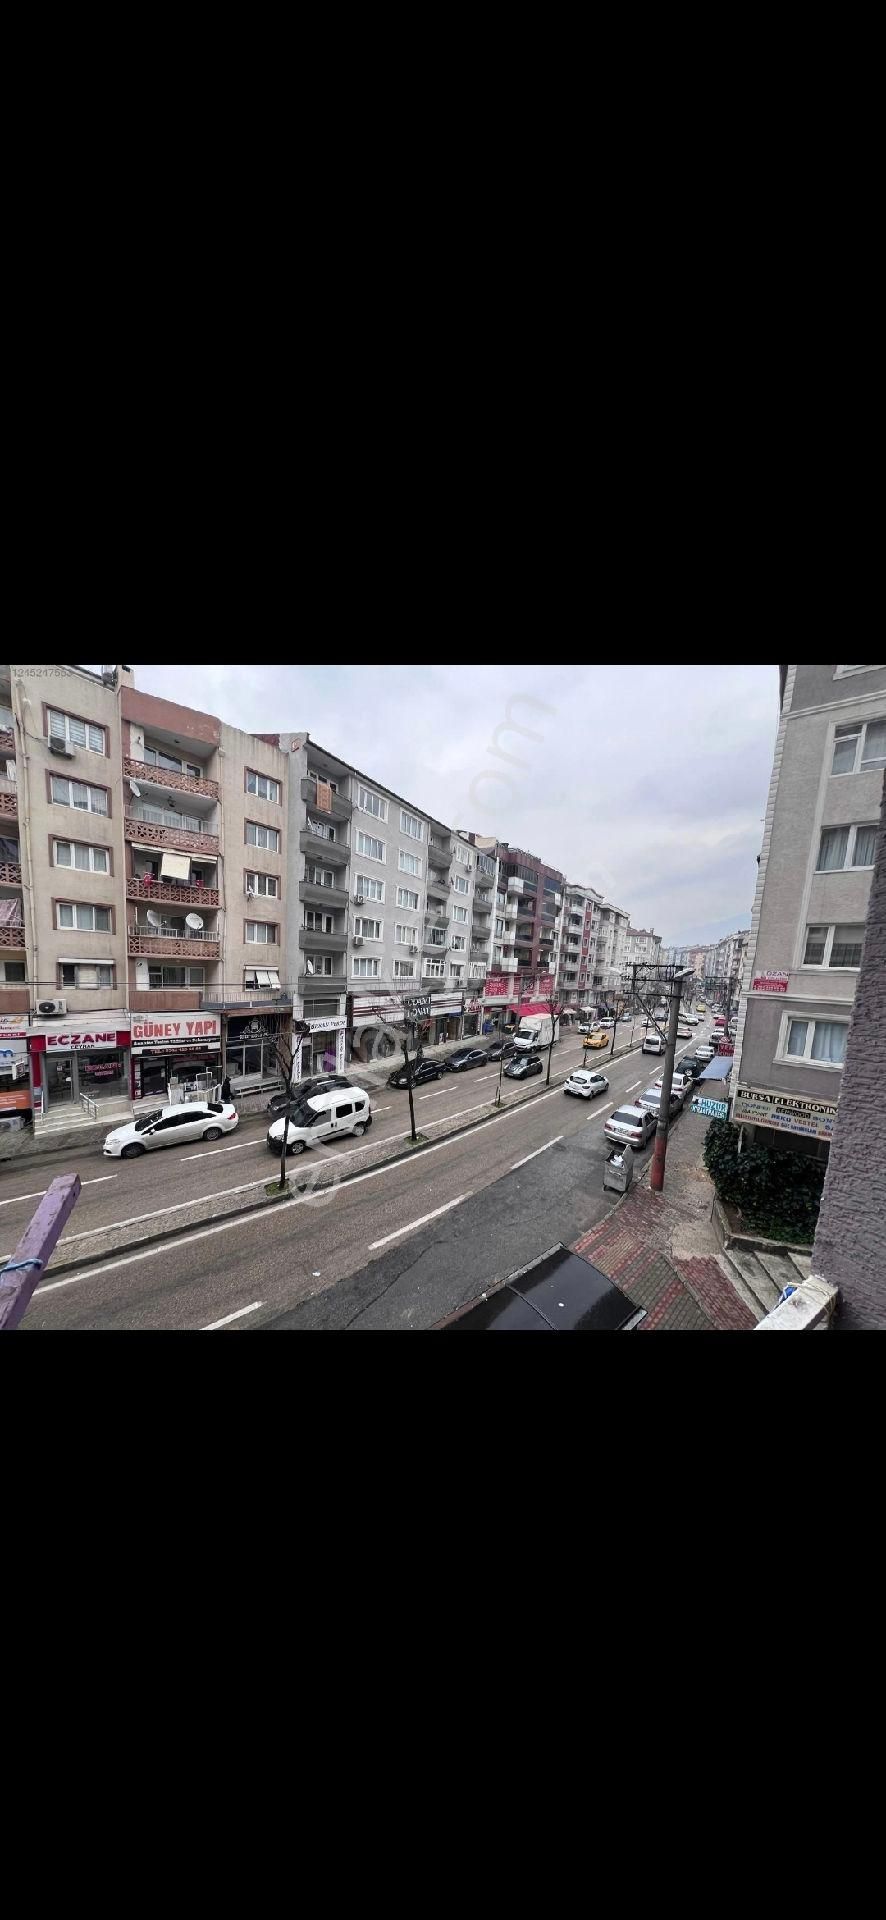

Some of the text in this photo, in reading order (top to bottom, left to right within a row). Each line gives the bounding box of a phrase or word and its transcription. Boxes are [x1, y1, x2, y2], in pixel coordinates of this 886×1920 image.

[133, 1019, 217, 1039] GÜNEY YAPI
[47, 1032, 116, 1046] ECZANE
[741, 1090, 771, 1104] BURSA
